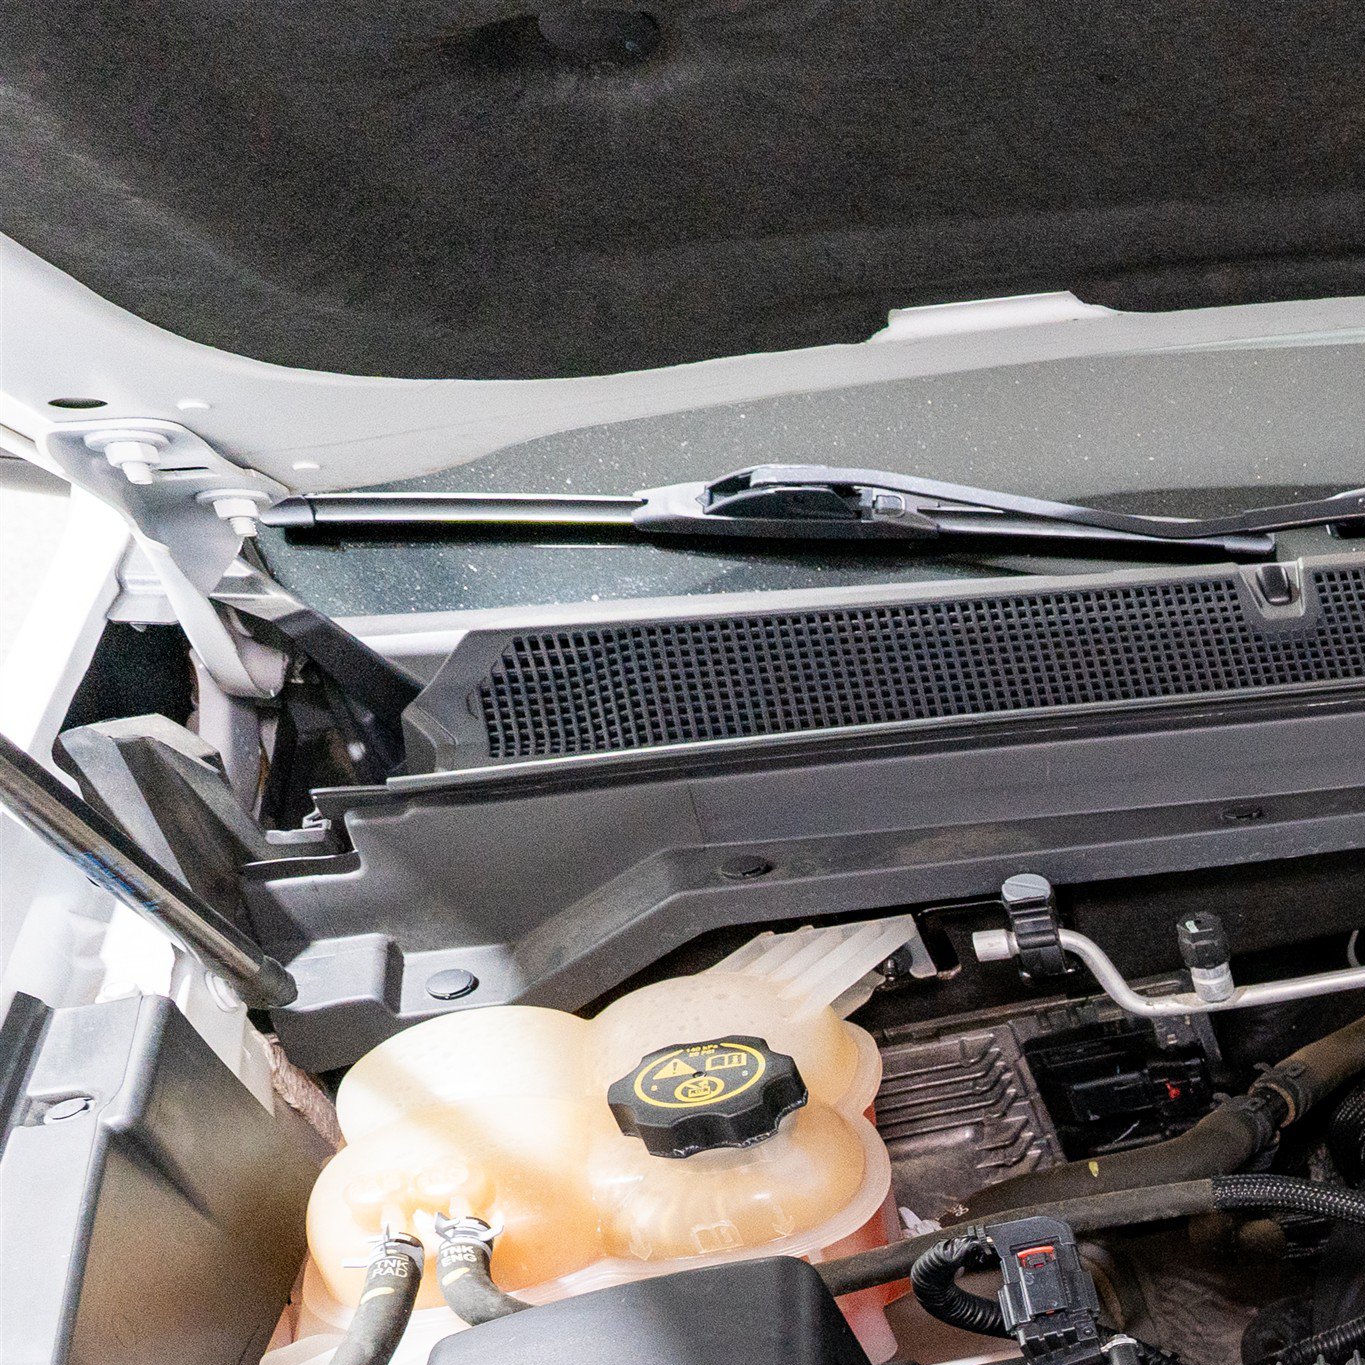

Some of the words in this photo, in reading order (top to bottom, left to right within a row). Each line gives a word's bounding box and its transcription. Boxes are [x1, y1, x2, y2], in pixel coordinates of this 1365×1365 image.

[440, 1245, 475, 1257] TNK
[374, 1259, 409, 1271] TNK
[440, 1253, 478, 1267] ENG
[371, 1267, 408, 1279] RAD
